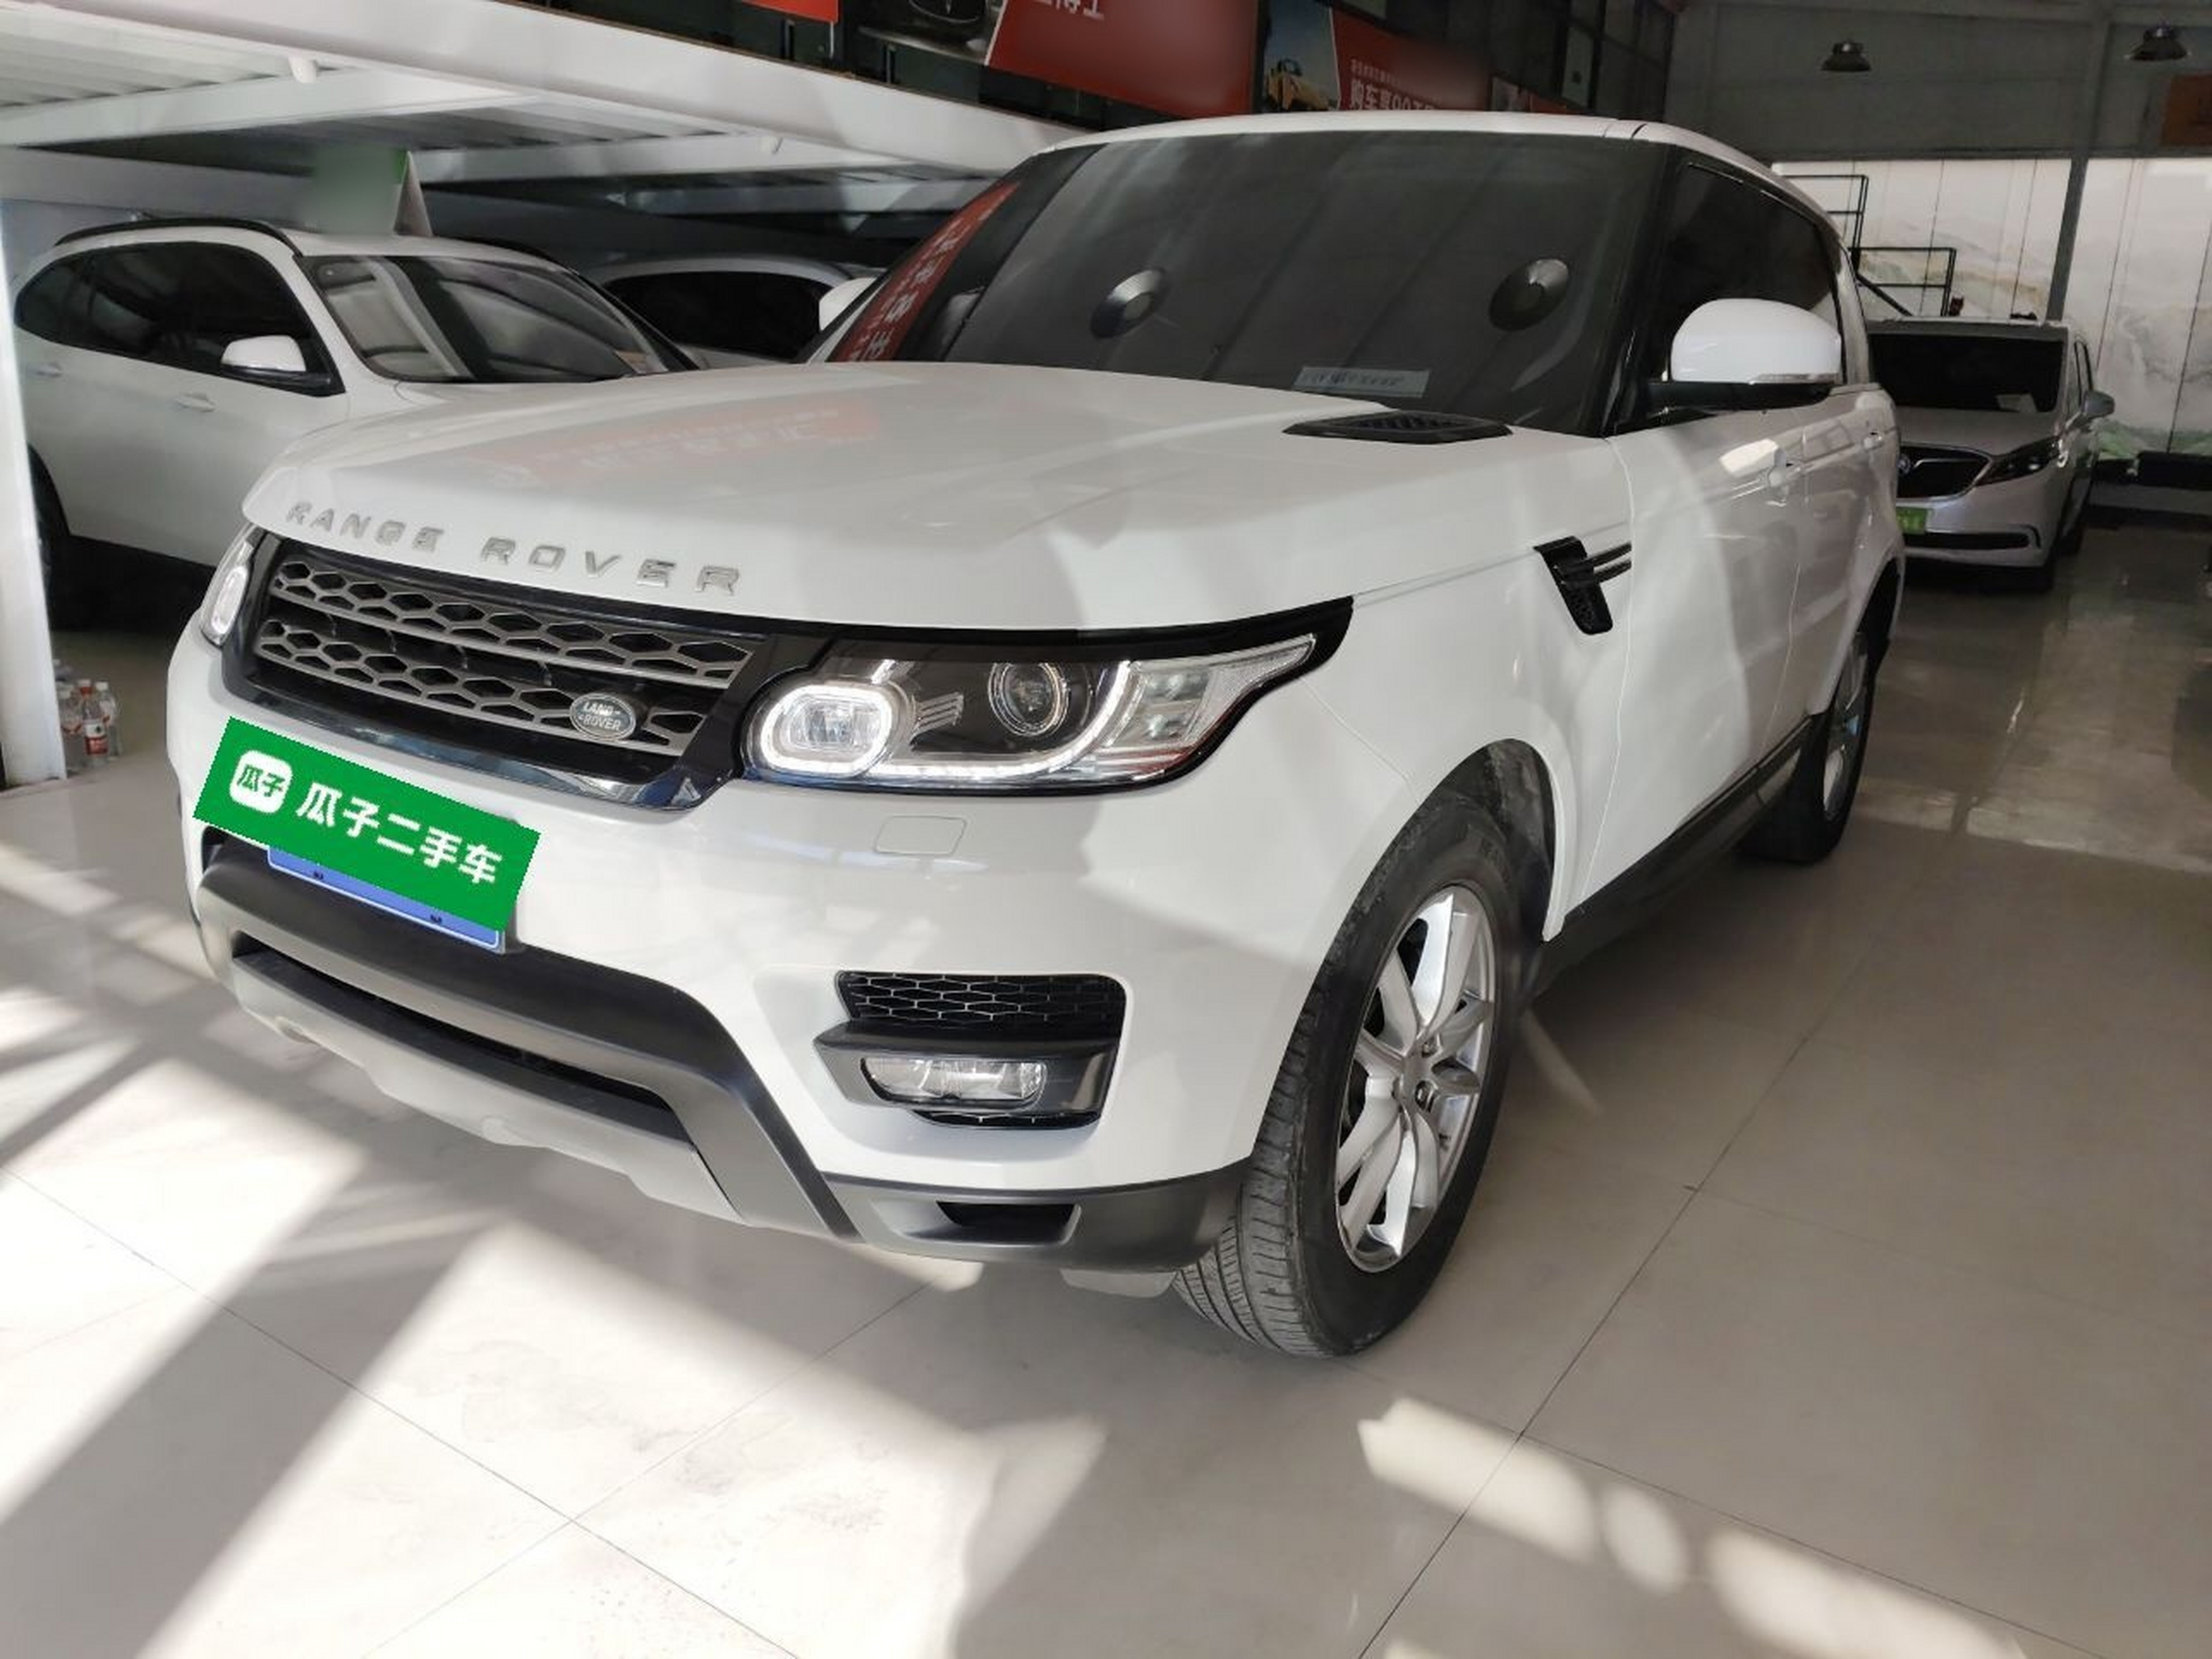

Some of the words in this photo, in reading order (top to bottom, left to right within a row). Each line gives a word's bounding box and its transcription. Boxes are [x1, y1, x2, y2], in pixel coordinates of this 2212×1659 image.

[286, 501, 444, 552] RANGE
[481, 536, 741, 596] ROVER
[583, 701, 614, 716] LAND
[584, 714, 620, 730] ROVER
